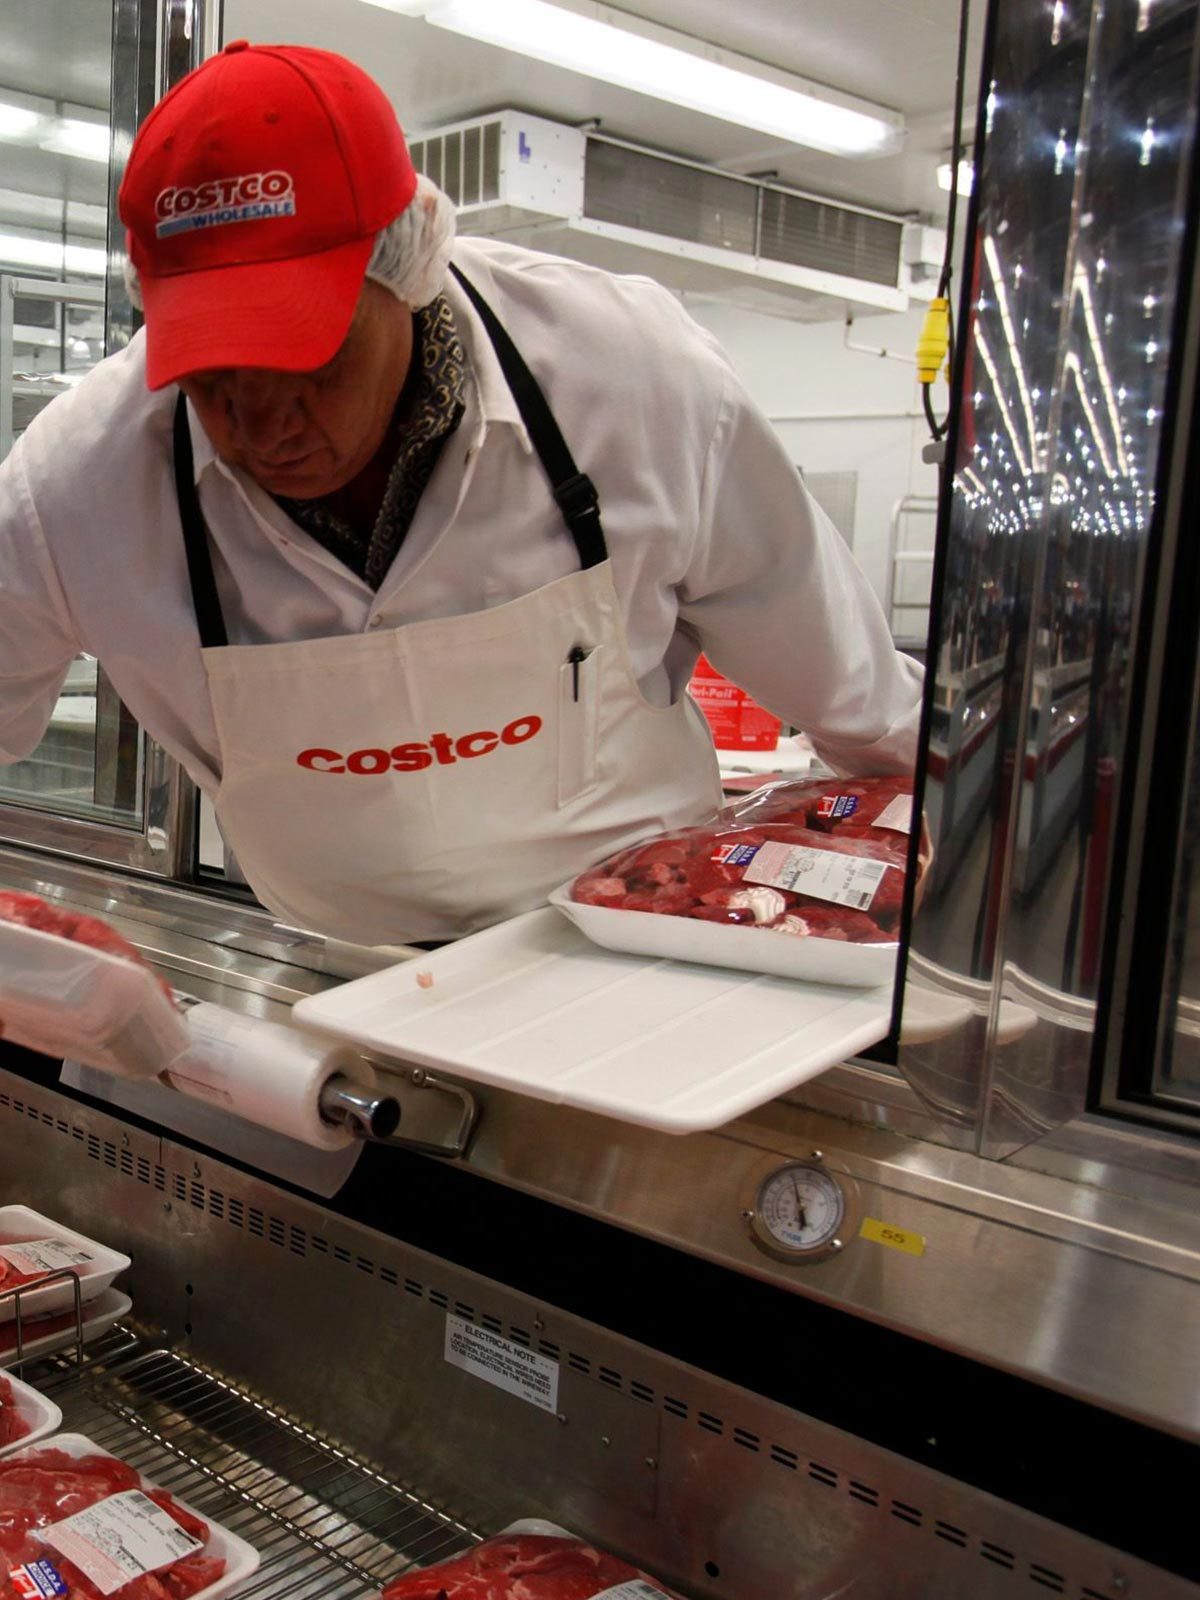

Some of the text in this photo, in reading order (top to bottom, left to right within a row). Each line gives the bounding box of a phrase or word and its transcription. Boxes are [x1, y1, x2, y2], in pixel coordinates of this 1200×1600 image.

[155, 170, 293, 219] COSTCO
[192, 202, 293, 227] WHOLESALE
[880, 1228, 905, 1244] 55
[465, 1324, 535, 1364] ELECTRICAL NOTE
[30, 1564, 52, 1592] CHOICE
[38, 1560, 62, 1591] U.S.D.A.
